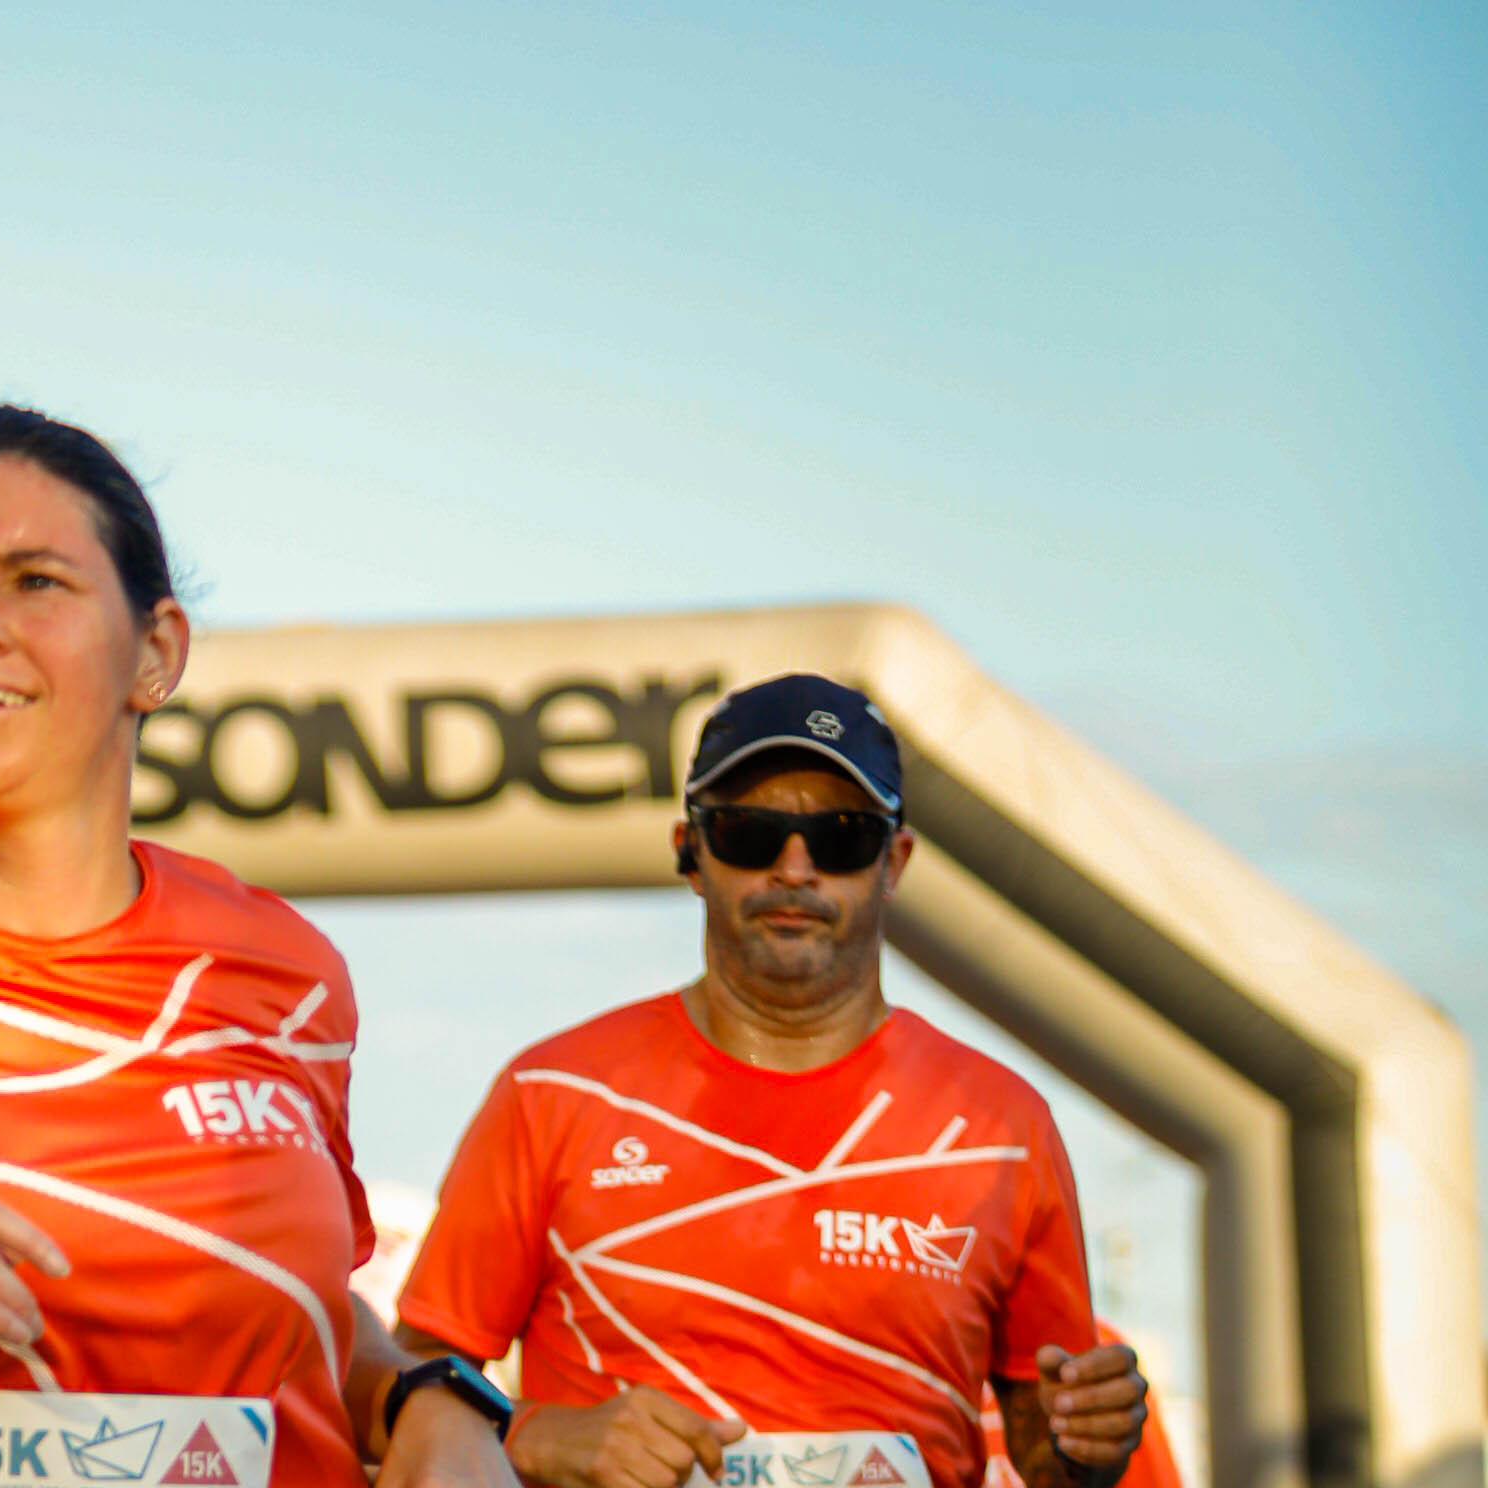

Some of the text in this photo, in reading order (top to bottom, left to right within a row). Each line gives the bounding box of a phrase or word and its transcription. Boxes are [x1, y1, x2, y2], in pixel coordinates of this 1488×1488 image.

[162, 1080, 297, 1137] 15K
[813, 1208, 901, 1257] 15K
[179, 1449, 226, 1478] 15K
[713, 1454, 775, 1486] 5K
